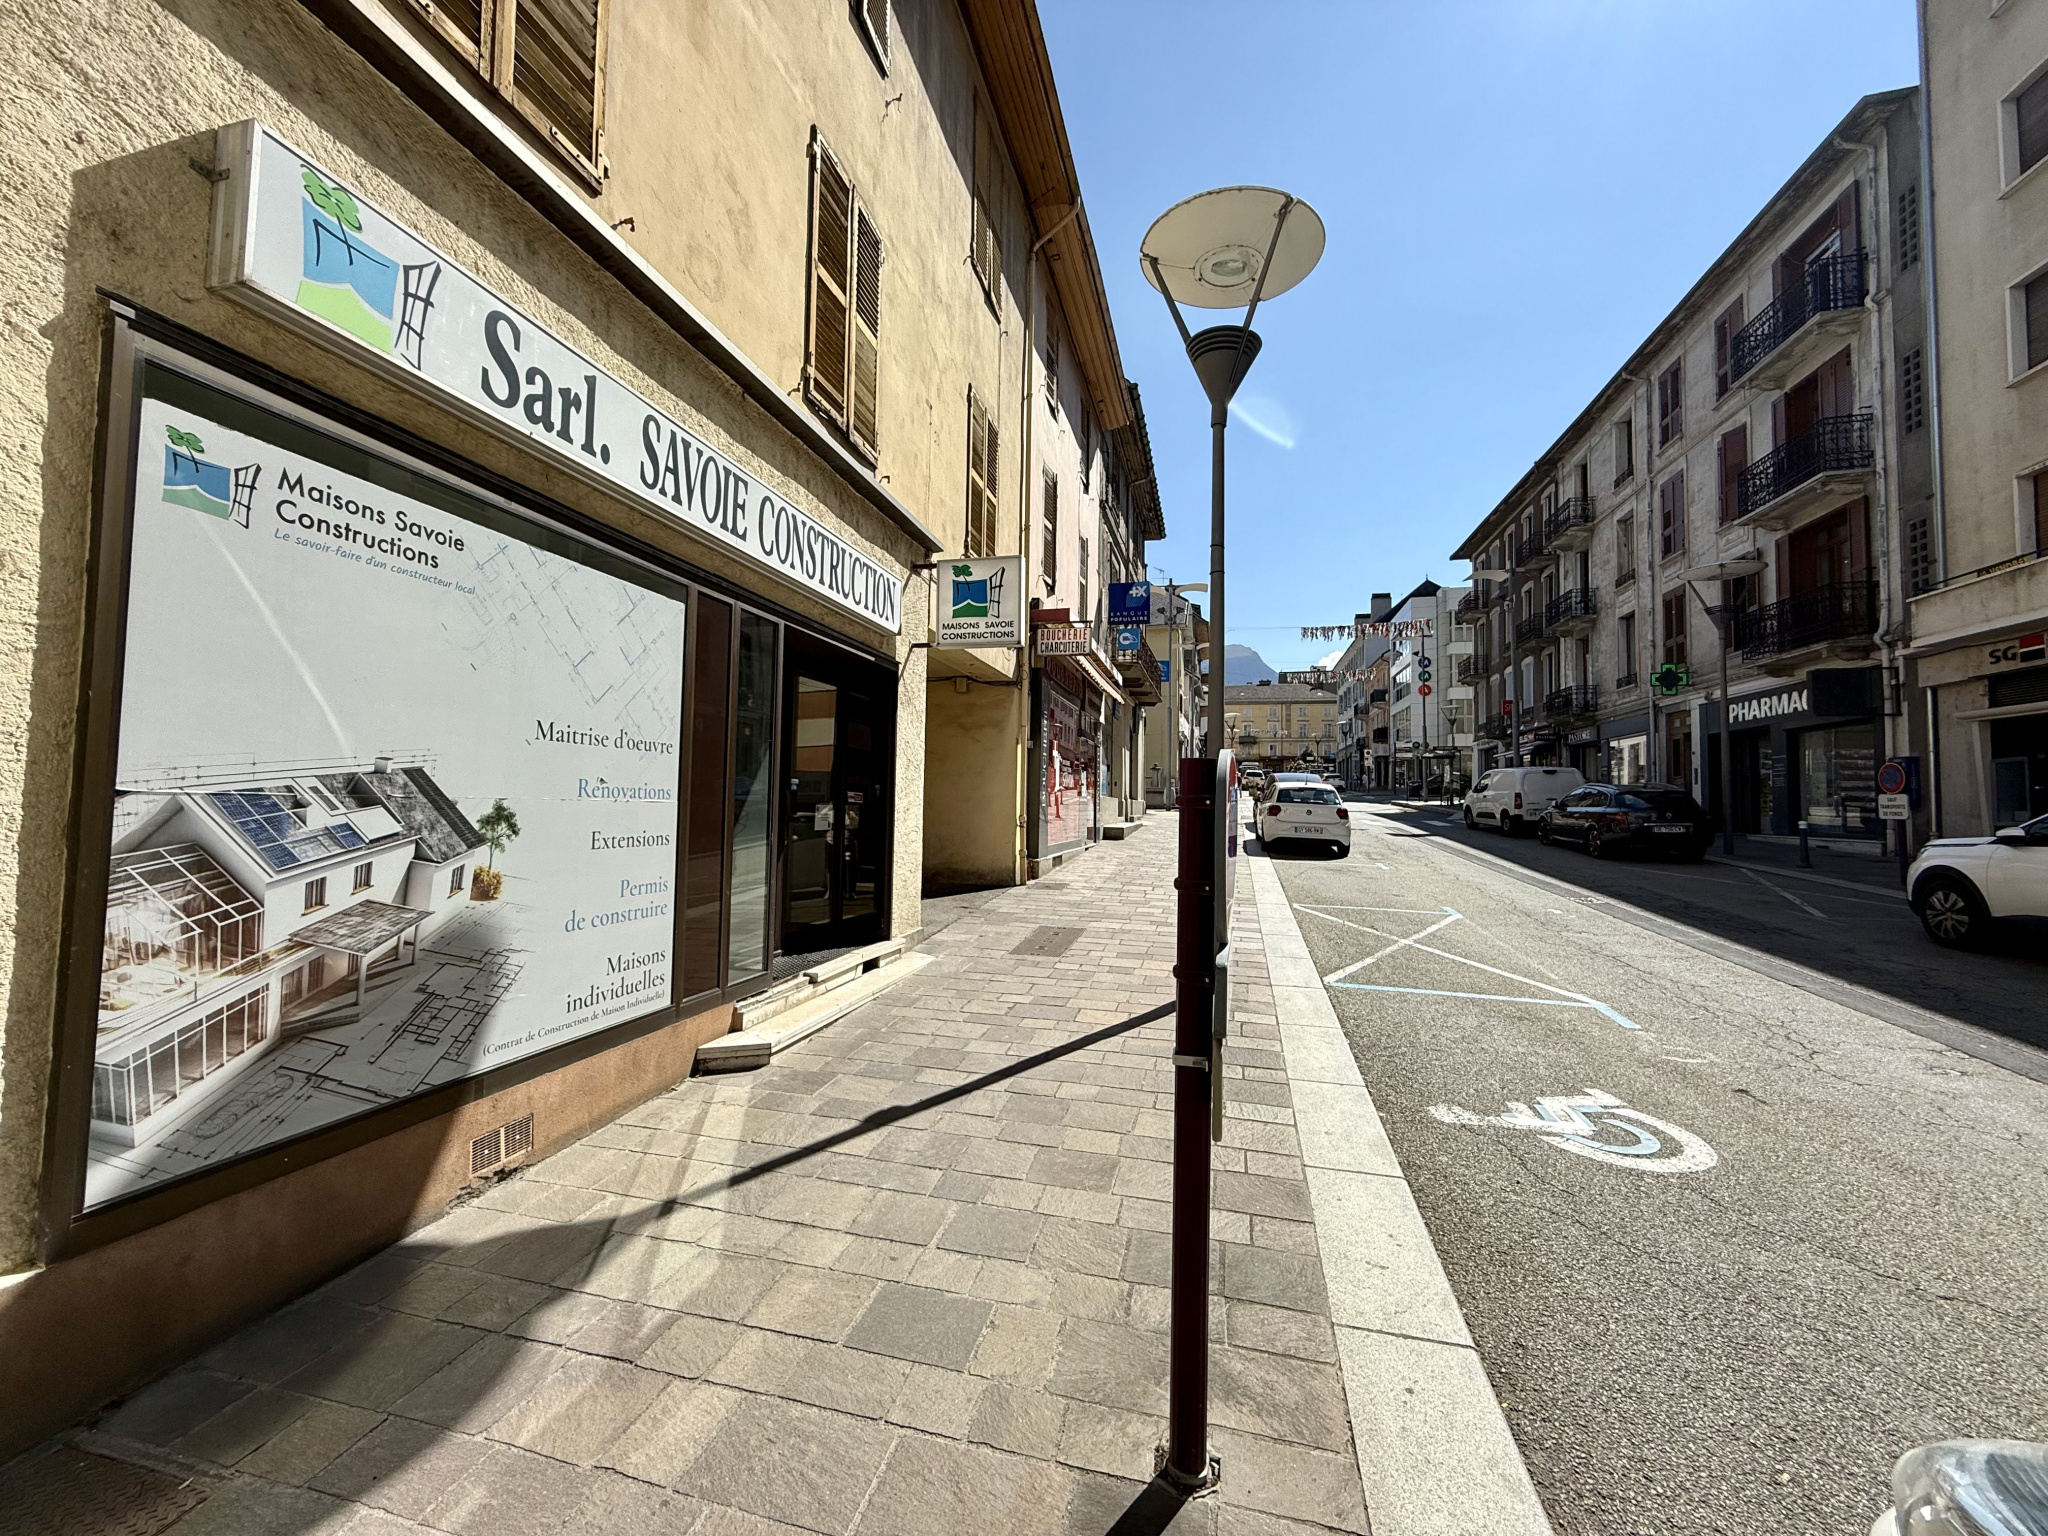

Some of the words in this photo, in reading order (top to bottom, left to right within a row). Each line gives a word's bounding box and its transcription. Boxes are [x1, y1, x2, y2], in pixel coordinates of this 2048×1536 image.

[481, 310, 611, 465] Sarl.
[640, 415, 749, 542] SAVOIE
[758, 495, 896, 625] CONSTRUCTION
[277, 467, 387, 527] Maisons
[394, 511, 466, 552] Savoie
[275, 499, 439, 569] Constructions
[274, 527, 287, 542] Le
[294, 535, 363, 565] savoir-faire
[390, 563, 452, 590] constructeur
[454, 577, 476, 595] local
[941, 630, 1015, 641] CONSTRUCTIONS
[942, 621, 980, 631] MAISONS
[984, 620, 1015, 629] SAVOIE
[1040, 628, 1088, 642] BOUCHERIE
[1040, 640, 1087, 653] CHARCUTERIE
[1989, 644, 2018, 664] SG
[534, 719, 609, 748] Maitrise
[614, 728, 673, 755] d'oeuvre
[1568, 729, 1591, 743] PASTORE
[577, 776, 671, 801] Rénovations
[590, 830, 670, 850] Extensions
[619, 876, 668, 898] Permis
[564, 909, 586, 933] de
[590, 901, 668, 929] construire
[605, 949, 666, 976] Maisons
[565, 971, 665, 1013] individuelles
[482, 1037, 523, 1057] (Contrat
[525, 1030, 536, 1041] de
[537, 1014, 589, 1039] Construction
[590, 1010, 599, 1021] de
[601, 1001, 625, 1017] Maison
[626, 989, 665, 1011] Individuelle)
